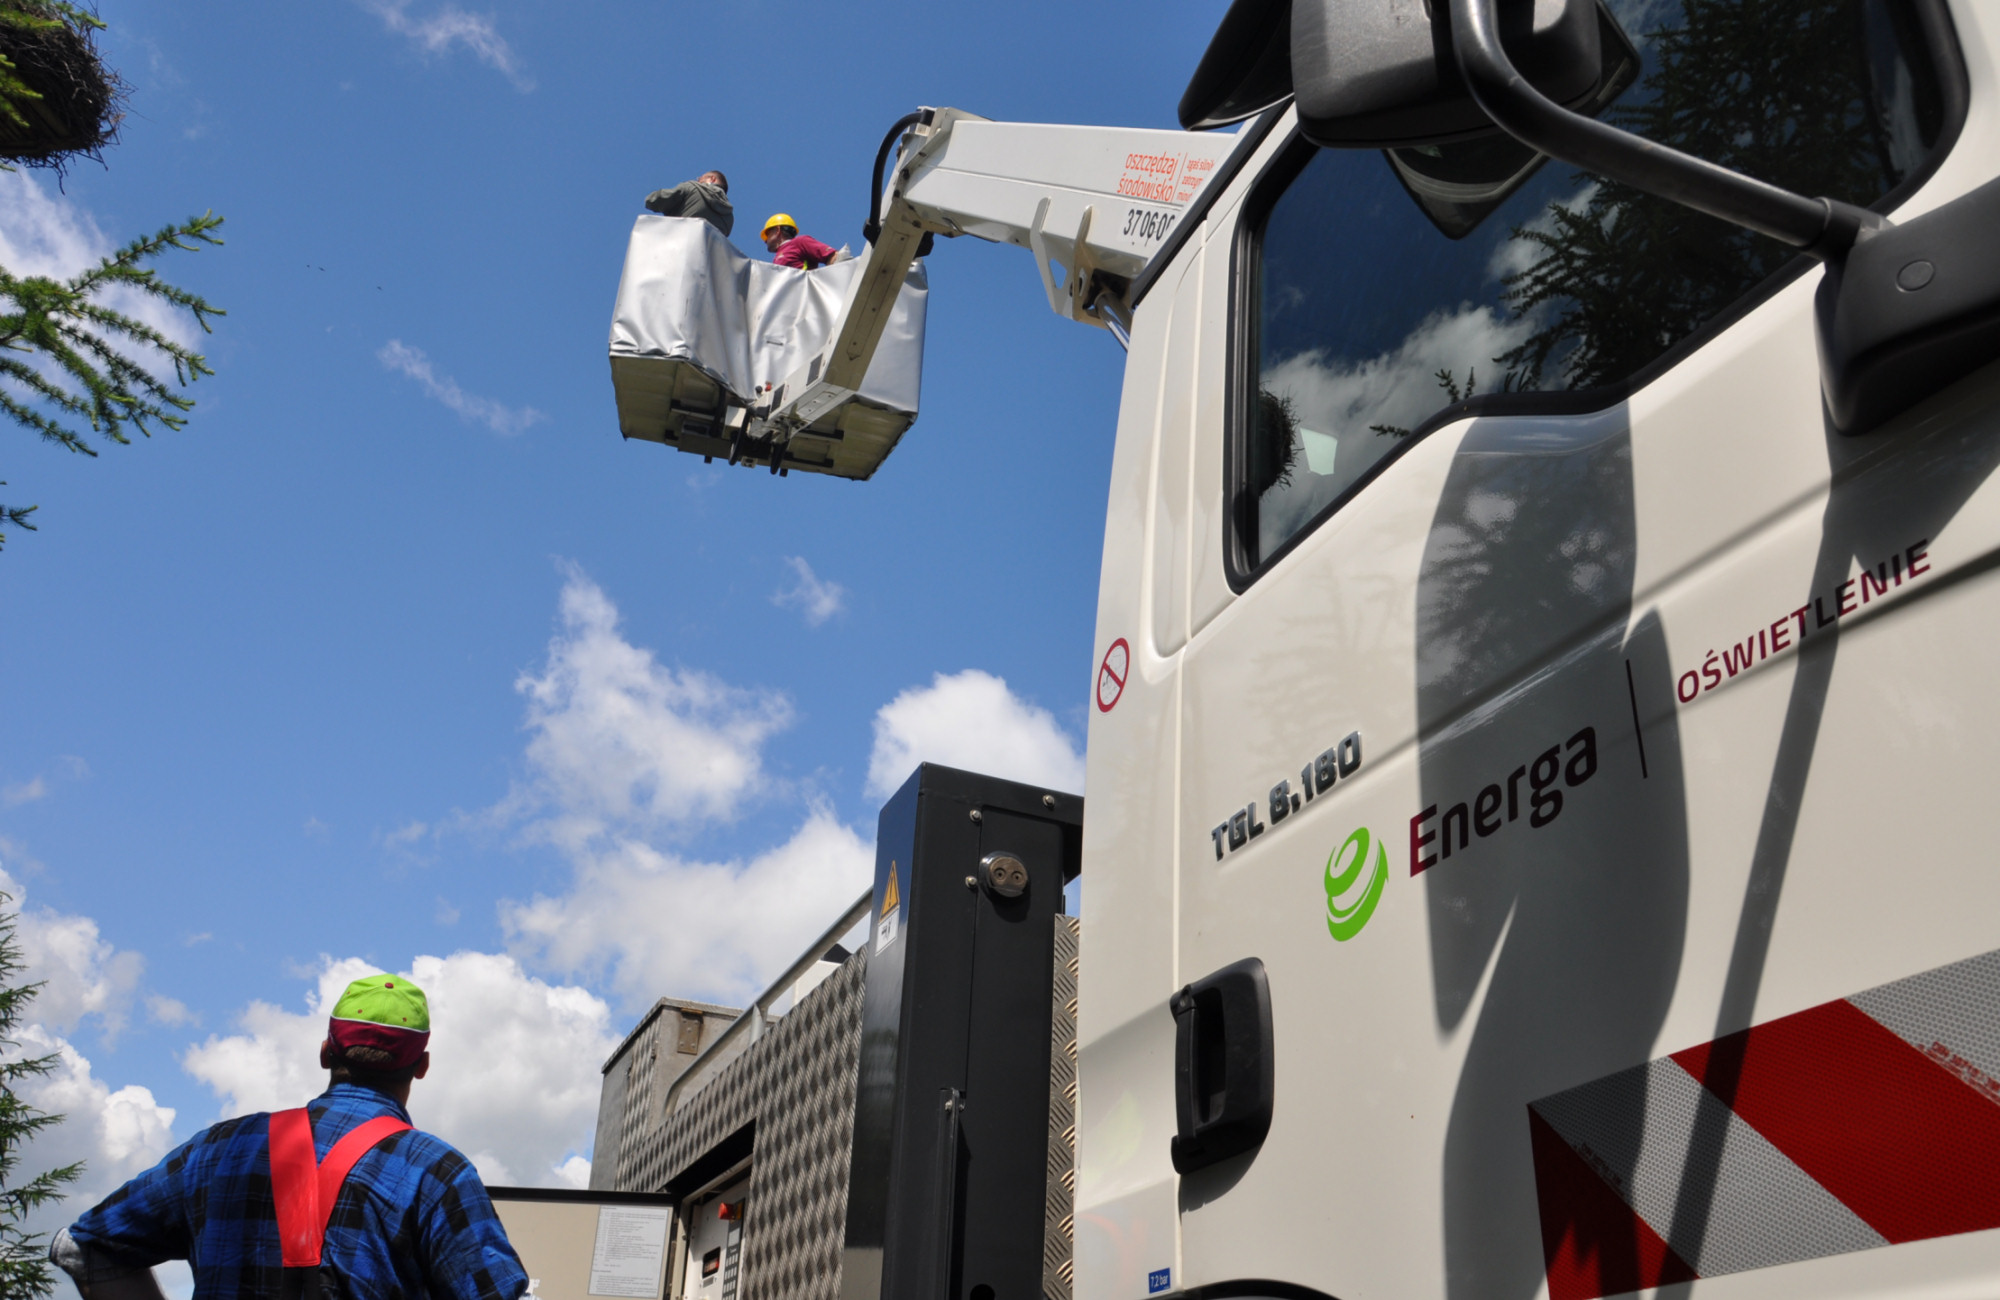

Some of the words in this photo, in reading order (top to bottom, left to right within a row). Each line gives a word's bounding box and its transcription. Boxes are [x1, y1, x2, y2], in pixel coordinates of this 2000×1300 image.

[1125, 151, 1181, 181] oszczędzaj
[1117, 172, 1173, 202] środowisko
[1410, 726, 1598, 878] Energa
[1677, 538, 1931, 703] OŚWIETLENIE
[1211, 801, 1265, 862] TGL
[1160, 1275, 1168, 1285] bar
